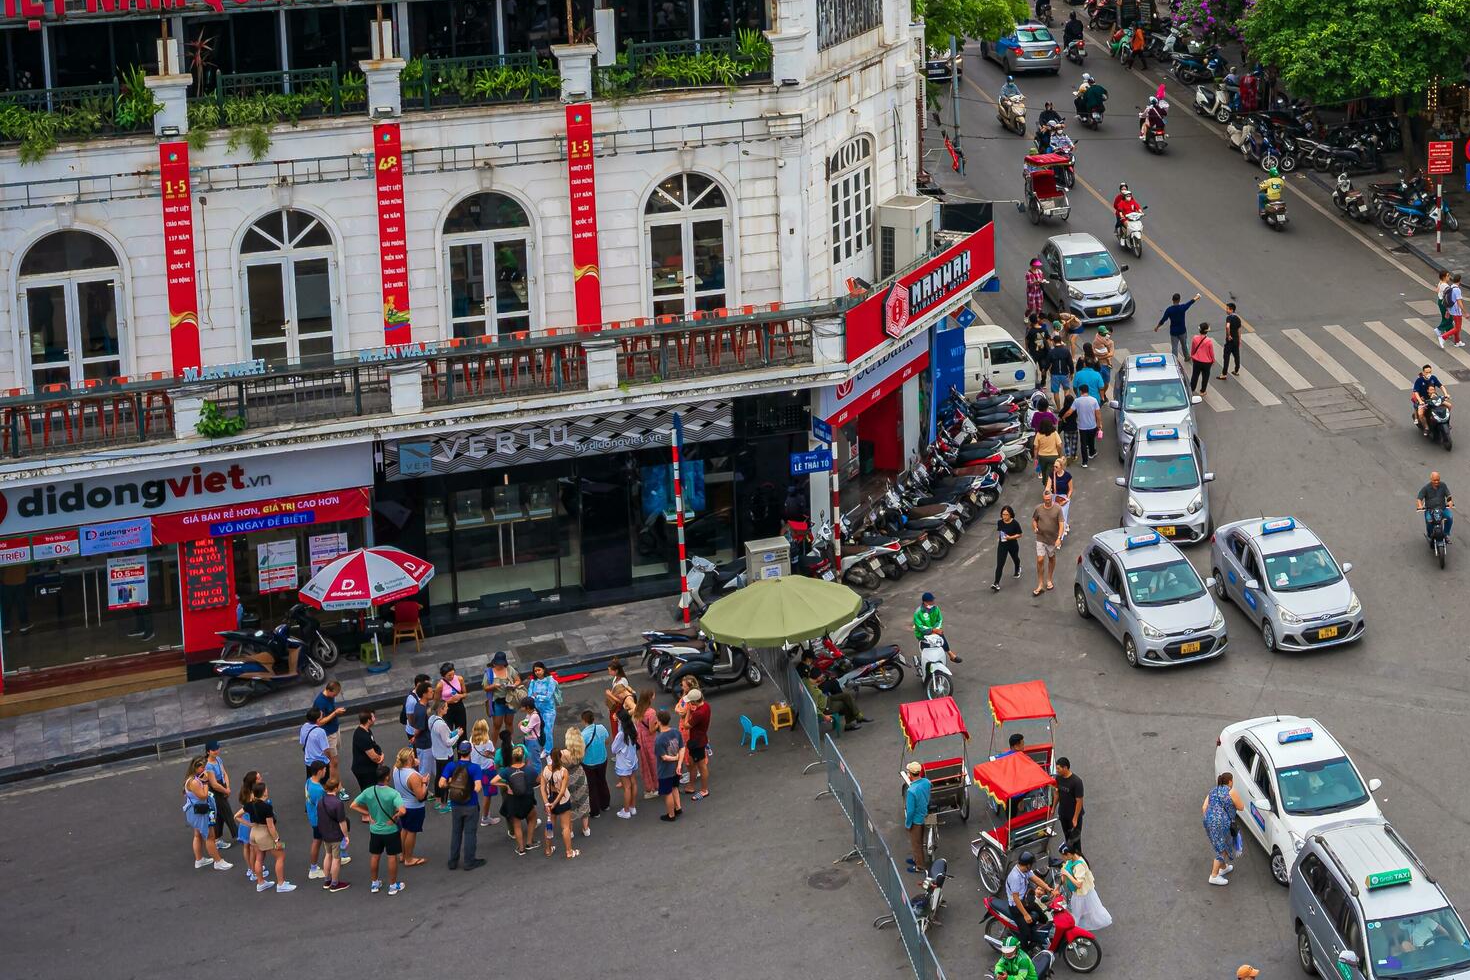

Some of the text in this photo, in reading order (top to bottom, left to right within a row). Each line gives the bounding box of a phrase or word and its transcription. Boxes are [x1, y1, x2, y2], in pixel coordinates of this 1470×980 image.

[911, 250, 971, 305] MANWAH
[574, 440, 587, 453] by
[588, 433, 662, 451] didongviet.vn
[804, 459, 819, 470] THÁI
[17, 464, 272, 518] didongviet.vn
[183, 511, 199, 525] GIÁ
[201, 510, 221, 523] BÁN
[262, 501, 279, 514] GIÁ
[280, 501, 296, 513] TRỊ
[297, 498, 316, 509] CAO
[318, 495, 340, 507] HƠN
[235, 519, 264, 532] NGAY
[283, 513, 307, 526] BIẾT!
[54, 543, 71, 554] 0%
[1394, 871, 1410, 881] TAXI
